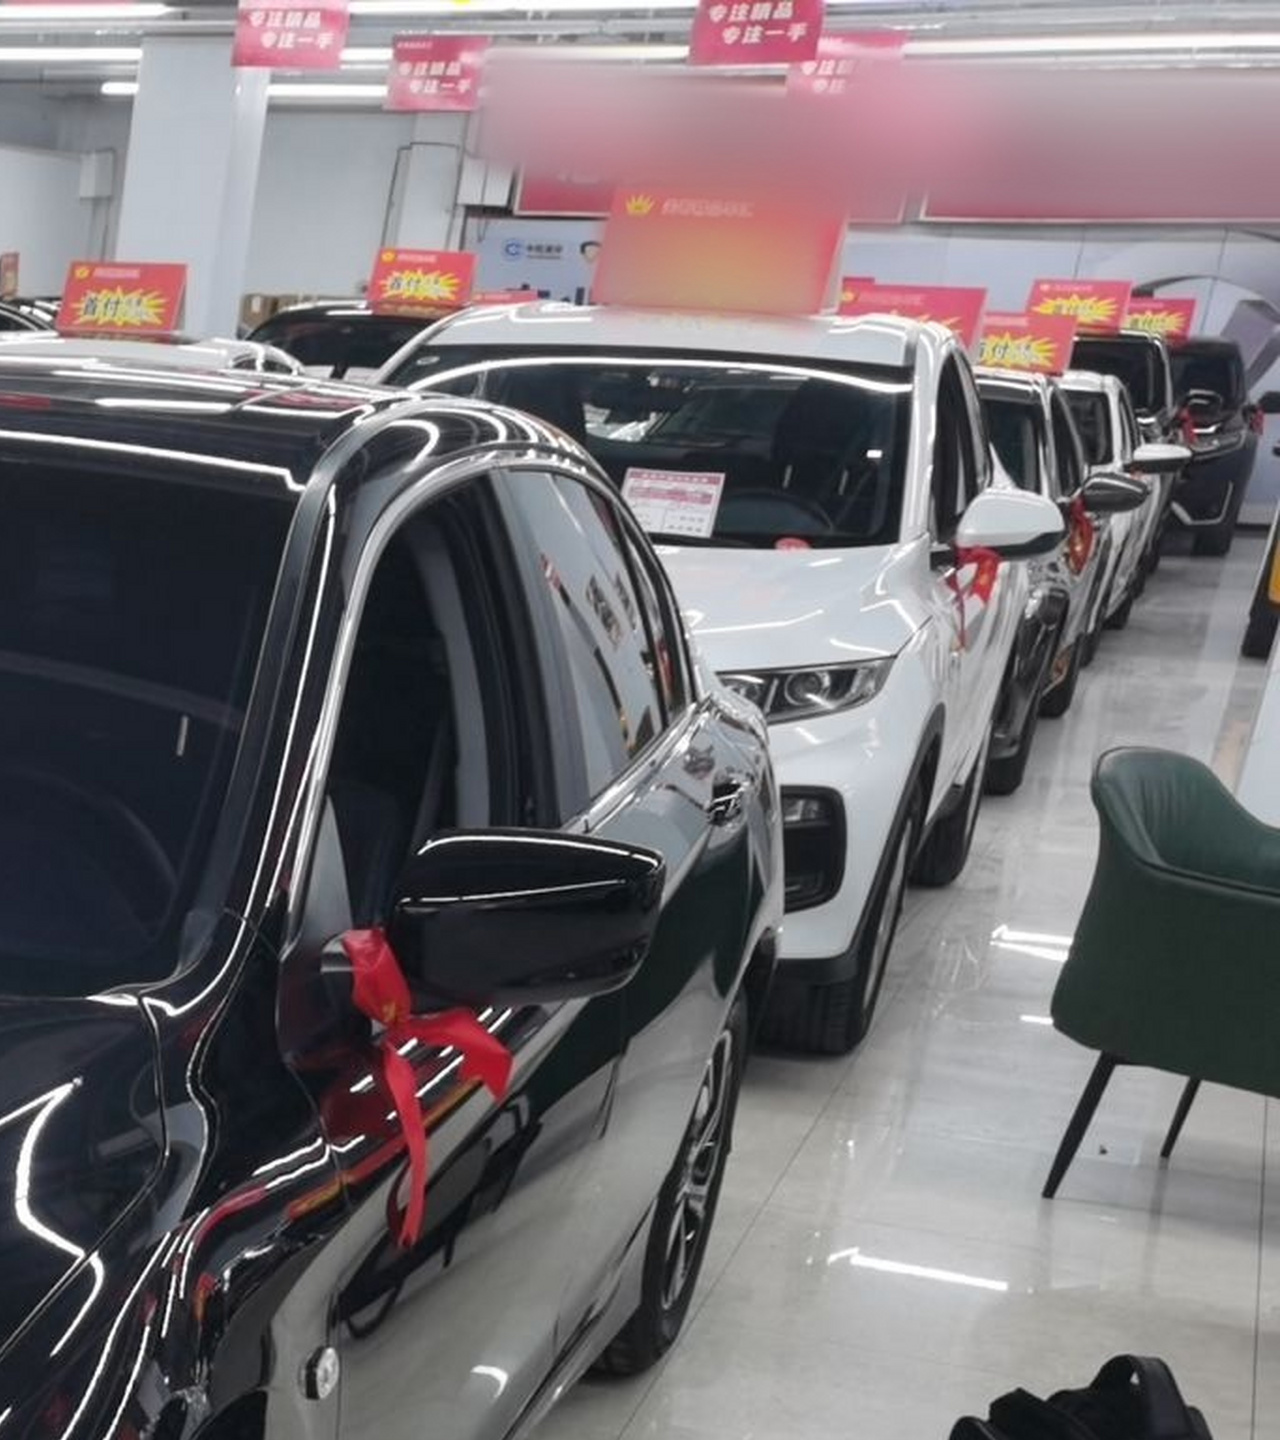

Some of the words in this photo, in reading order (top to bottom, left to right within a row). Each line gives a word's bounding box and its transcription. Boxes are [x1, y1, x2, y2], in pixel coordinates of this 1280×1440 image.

[708, 1, 794, 22] 专注精品
[260, 32, 334, 49] 专注一手
[722, 23, 807, 45] 专注一手
[84, 296, 120, 317] 首付
